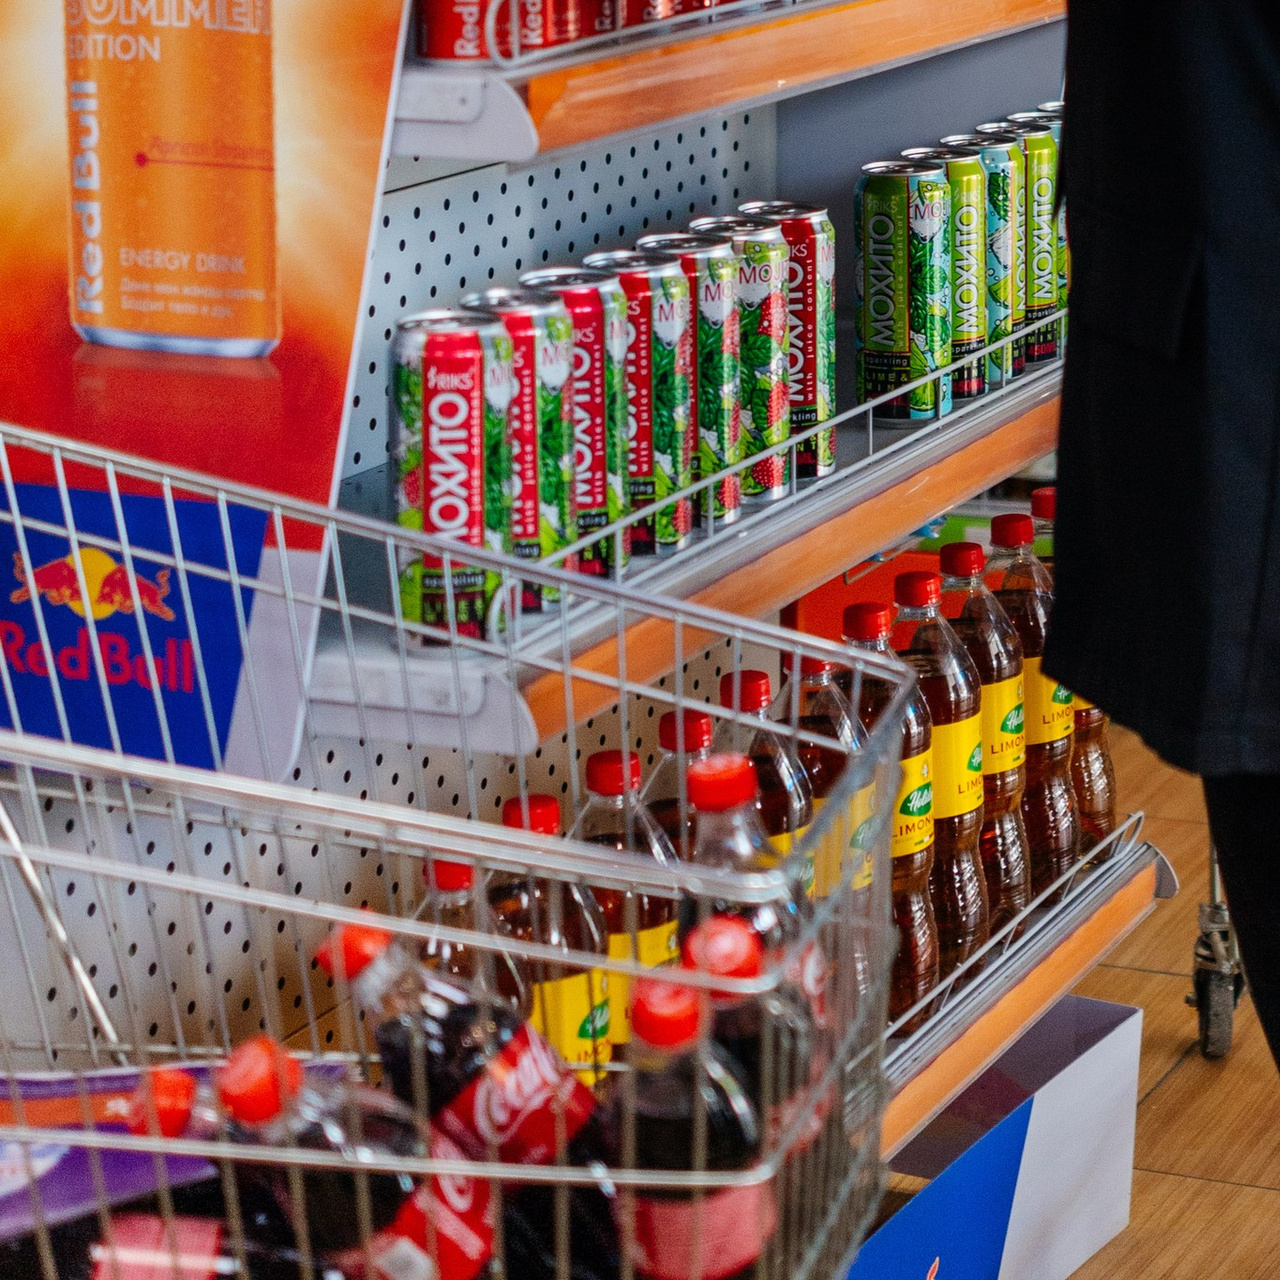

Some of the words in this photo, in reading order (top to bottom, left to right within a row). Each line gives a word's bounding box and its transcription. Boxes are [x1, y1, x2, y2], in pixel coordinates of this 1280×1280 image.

[452, 3, 480, 56] Red
[69, 81, 100, 191] Bull
[75, 201, 104, 314] Red
[119, 246, 191, 270] ENERGY
[196, 251, 246, 274] DRINK
[1032, 176, 1054, 299] МОХИТО
[806, 258, 814, 313] content
[868, 214, 896, 347] МОХИТО
[954, 204, 979, 333] МОХИТО
[806, 324, 815, 360] juice
[806, 372, 814, 402] with
[866, 382, 898, 393] MIN
[97, 630, 196, 694] Bull
